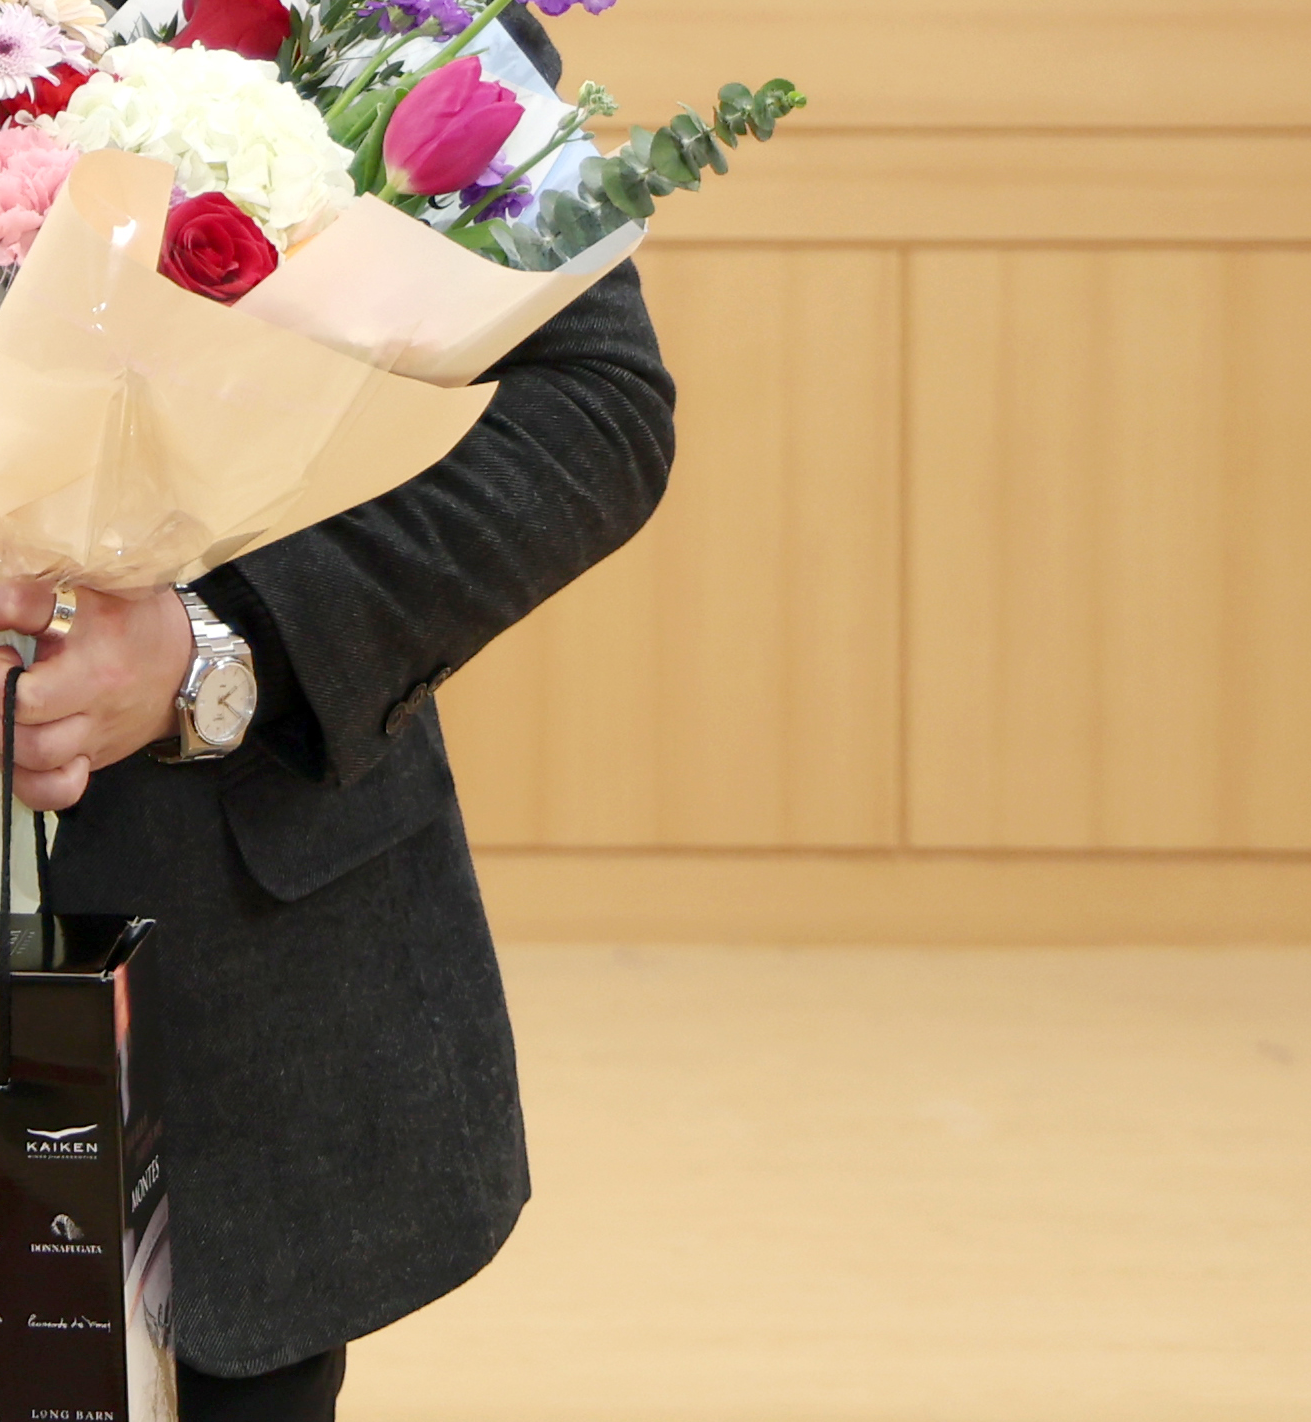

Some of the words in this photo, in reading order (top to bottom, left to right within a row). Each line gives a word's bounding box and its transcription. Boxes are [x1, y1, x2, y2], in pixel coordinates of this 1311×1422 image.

[27, 1141, 98, 1153] KAIKEN
[131, 1154, 161, 1213] MONTES
[30, 1243, 103, 1255] DONNAFUGATA
[31, 1409, 70, 1420] LONG
[76, 1409, 114, 1421] BARN
